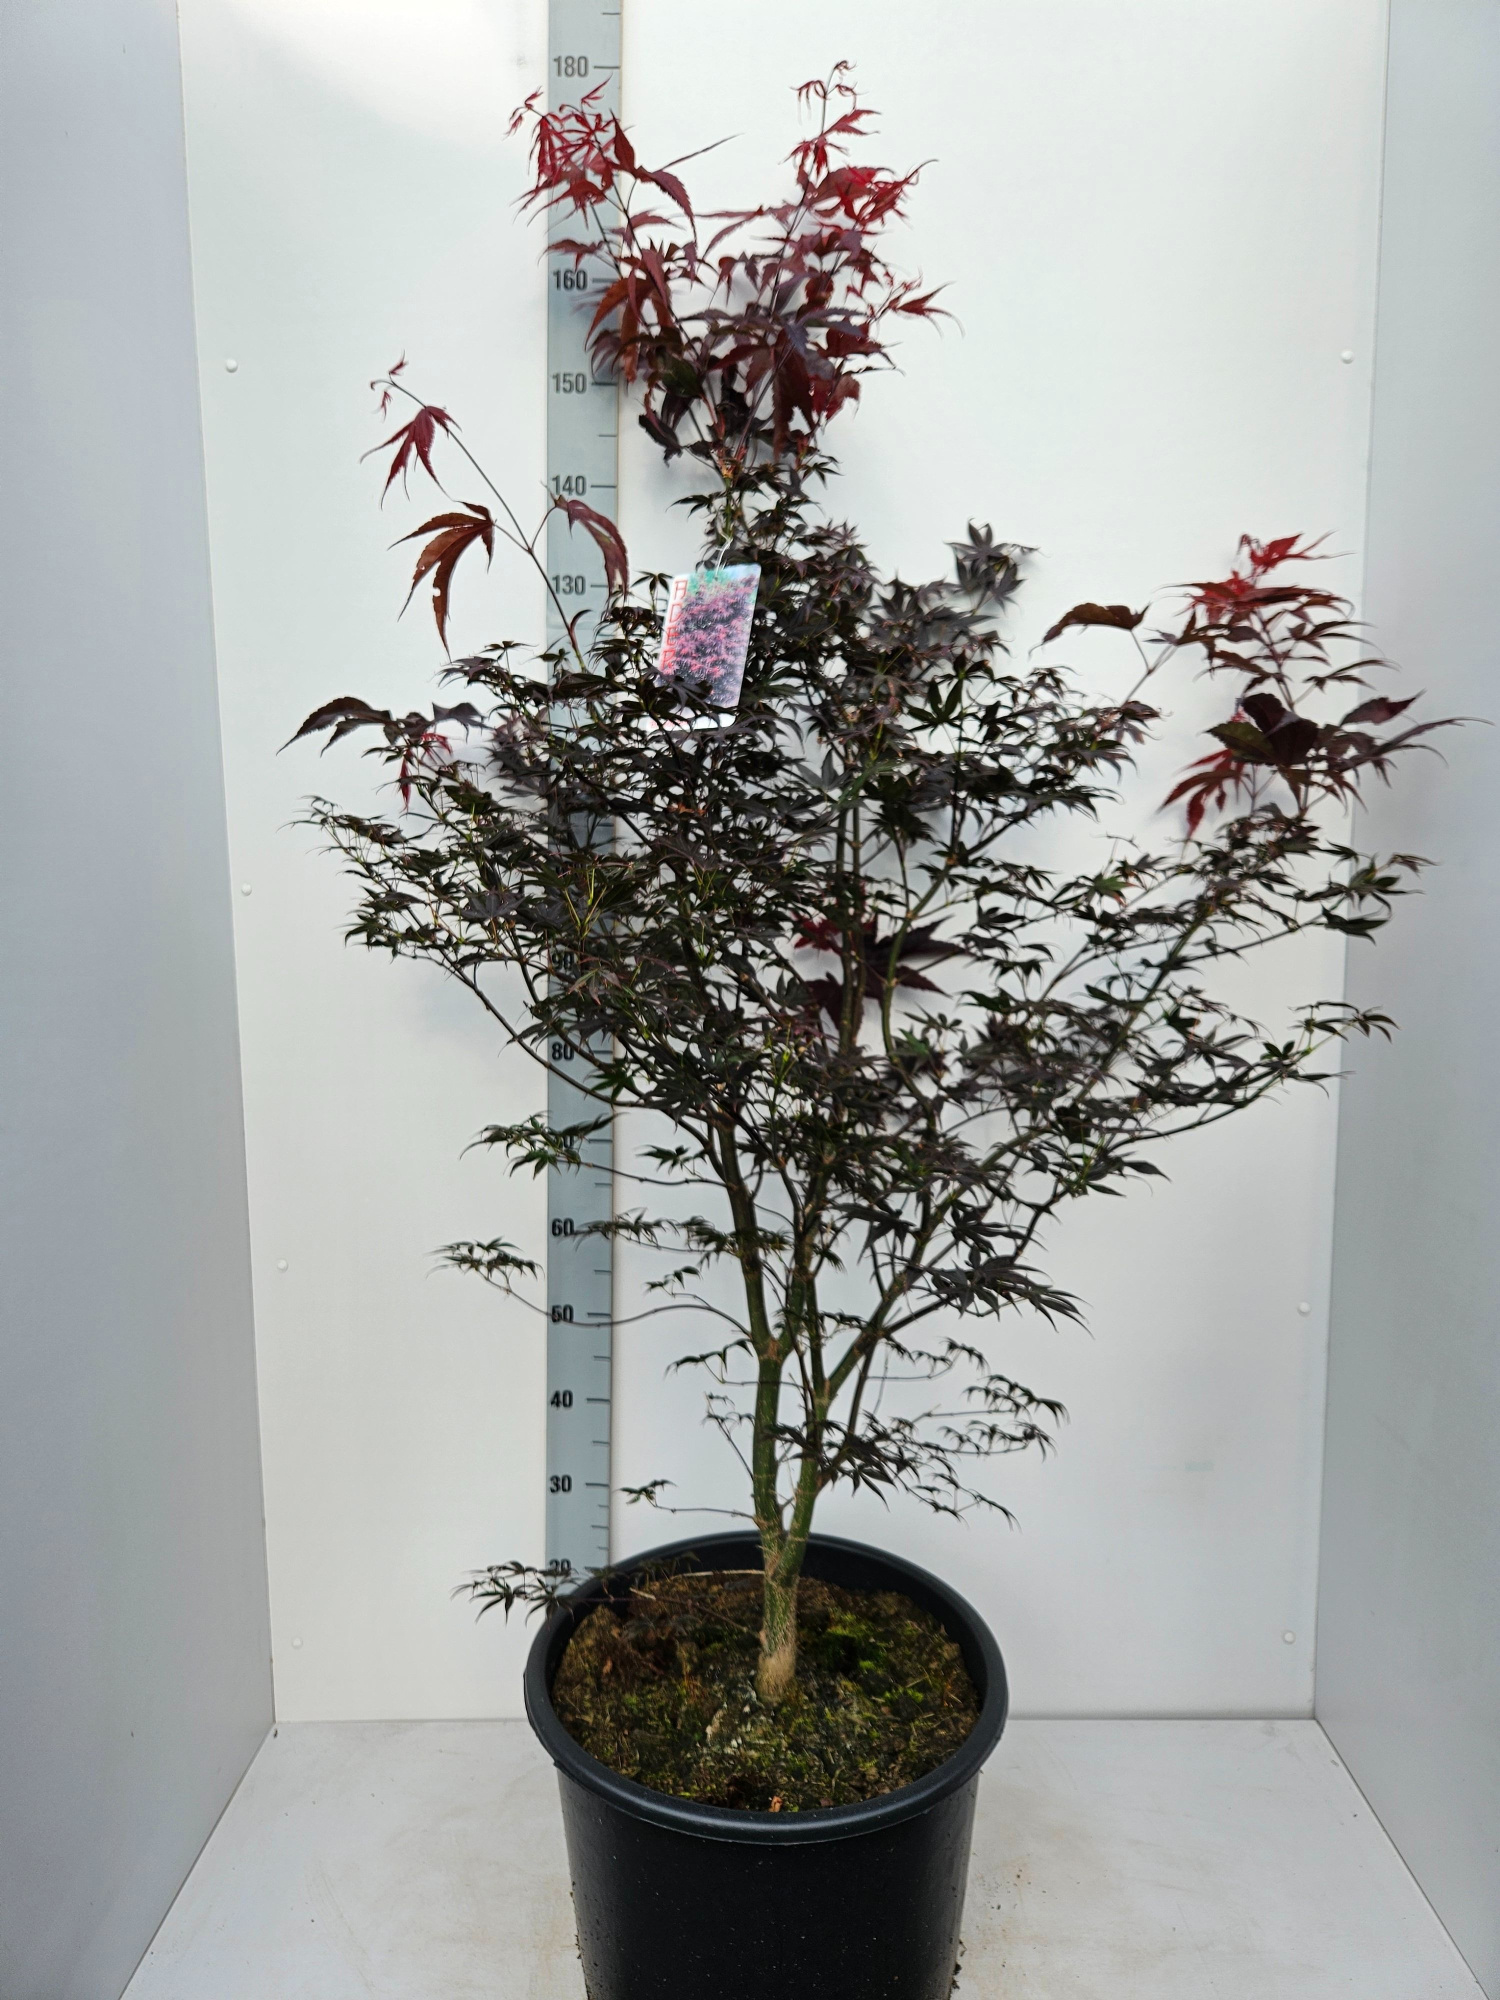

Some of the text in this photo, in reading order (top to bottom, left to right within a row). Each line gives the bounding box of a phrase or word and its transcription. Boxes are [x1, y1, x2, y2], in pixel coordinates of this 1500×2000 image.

[553, 56, 588, 77] 180
[553, 270, 588, 290] 160
[553, 373, 587, 394] 150
[552, 475, 587, 496] 140
[552, 575, 586, 595] 130
[551, 1042, 575, 1061] 80
[552, 1218, 575, 1237] 60
[551, 1305, 574, 1323] 50
[550, 1390, 574, 1408] 40
[549, 1475, 572, 1493] 30
